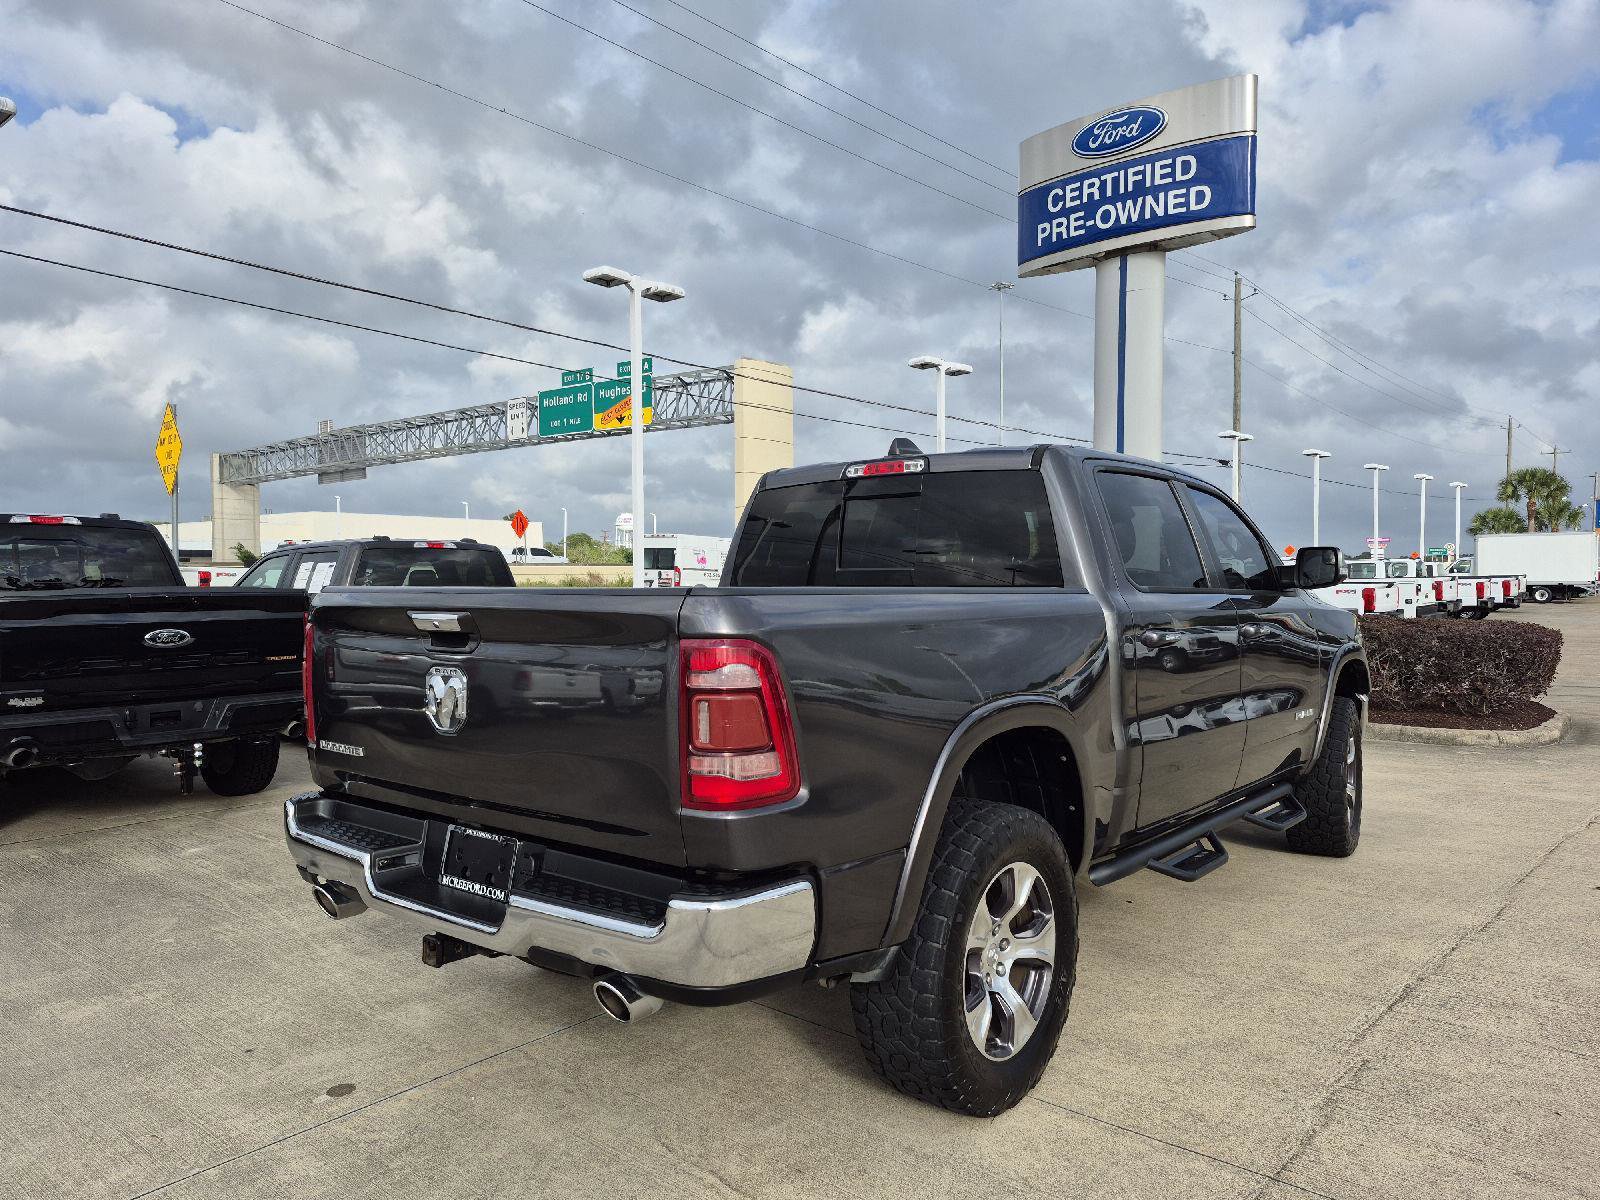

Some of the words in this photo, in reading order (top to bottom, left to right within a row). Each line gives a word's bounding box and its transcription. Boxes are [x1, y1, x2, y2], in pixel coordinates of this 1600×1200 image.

[1088, 114, 1144, 149] Ford
[1047, 154, 1198, 213] CERTIFIED
[1037, 185, 1212, 247] PRE-OWNED
[643, 361, 649, 371] A
[543, 393, 574, 408] Holland
[577, 391, 588, 403] Rd
[599, 385, 632, 400] Hughes
[508, 401, 526, 411] SPEED
[434, 668, 458, 676] RAM
[319, 740, 364, 757] LARAMIE
